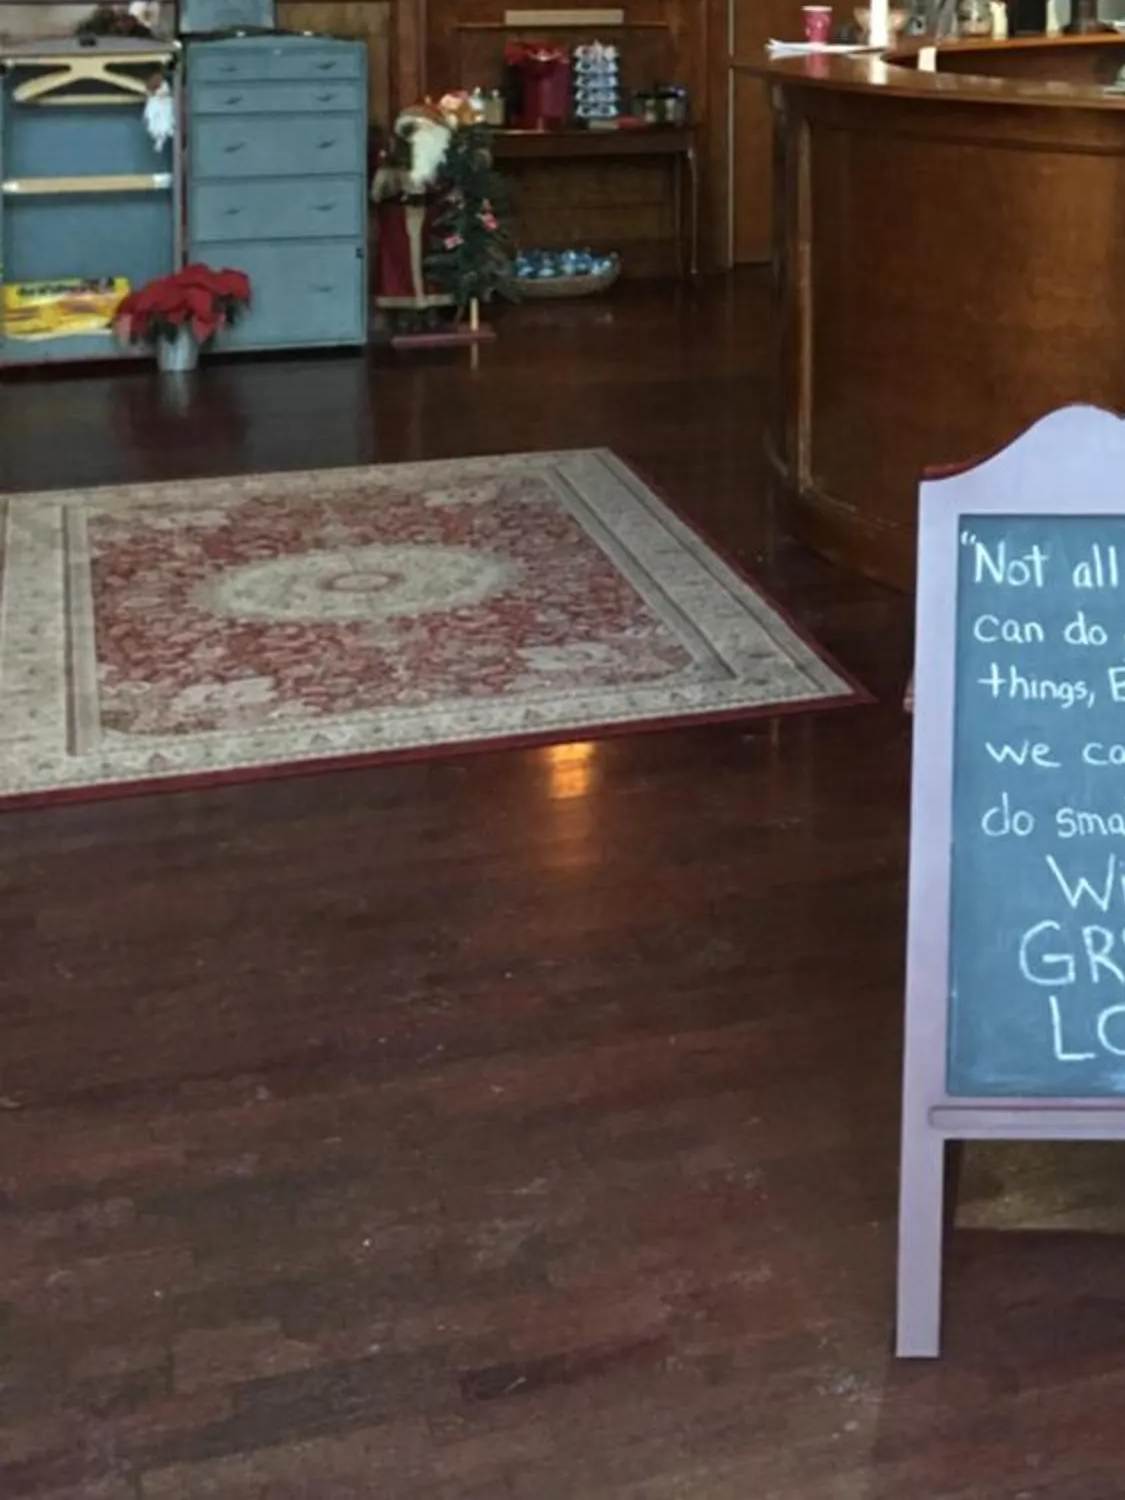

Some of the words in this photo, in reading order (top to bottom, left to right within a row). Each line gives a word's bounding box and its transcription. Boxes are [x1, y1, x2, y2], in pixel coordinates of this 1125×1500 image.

[1073, 543, 1118, 588] all
[973, 614, 1044, 643] can
[1063, 611, 1108, 646] do
[978, 662, 1095, 708] things,
[985, 741, 1061, 767] we
[981, 792, 1034, 836] do
